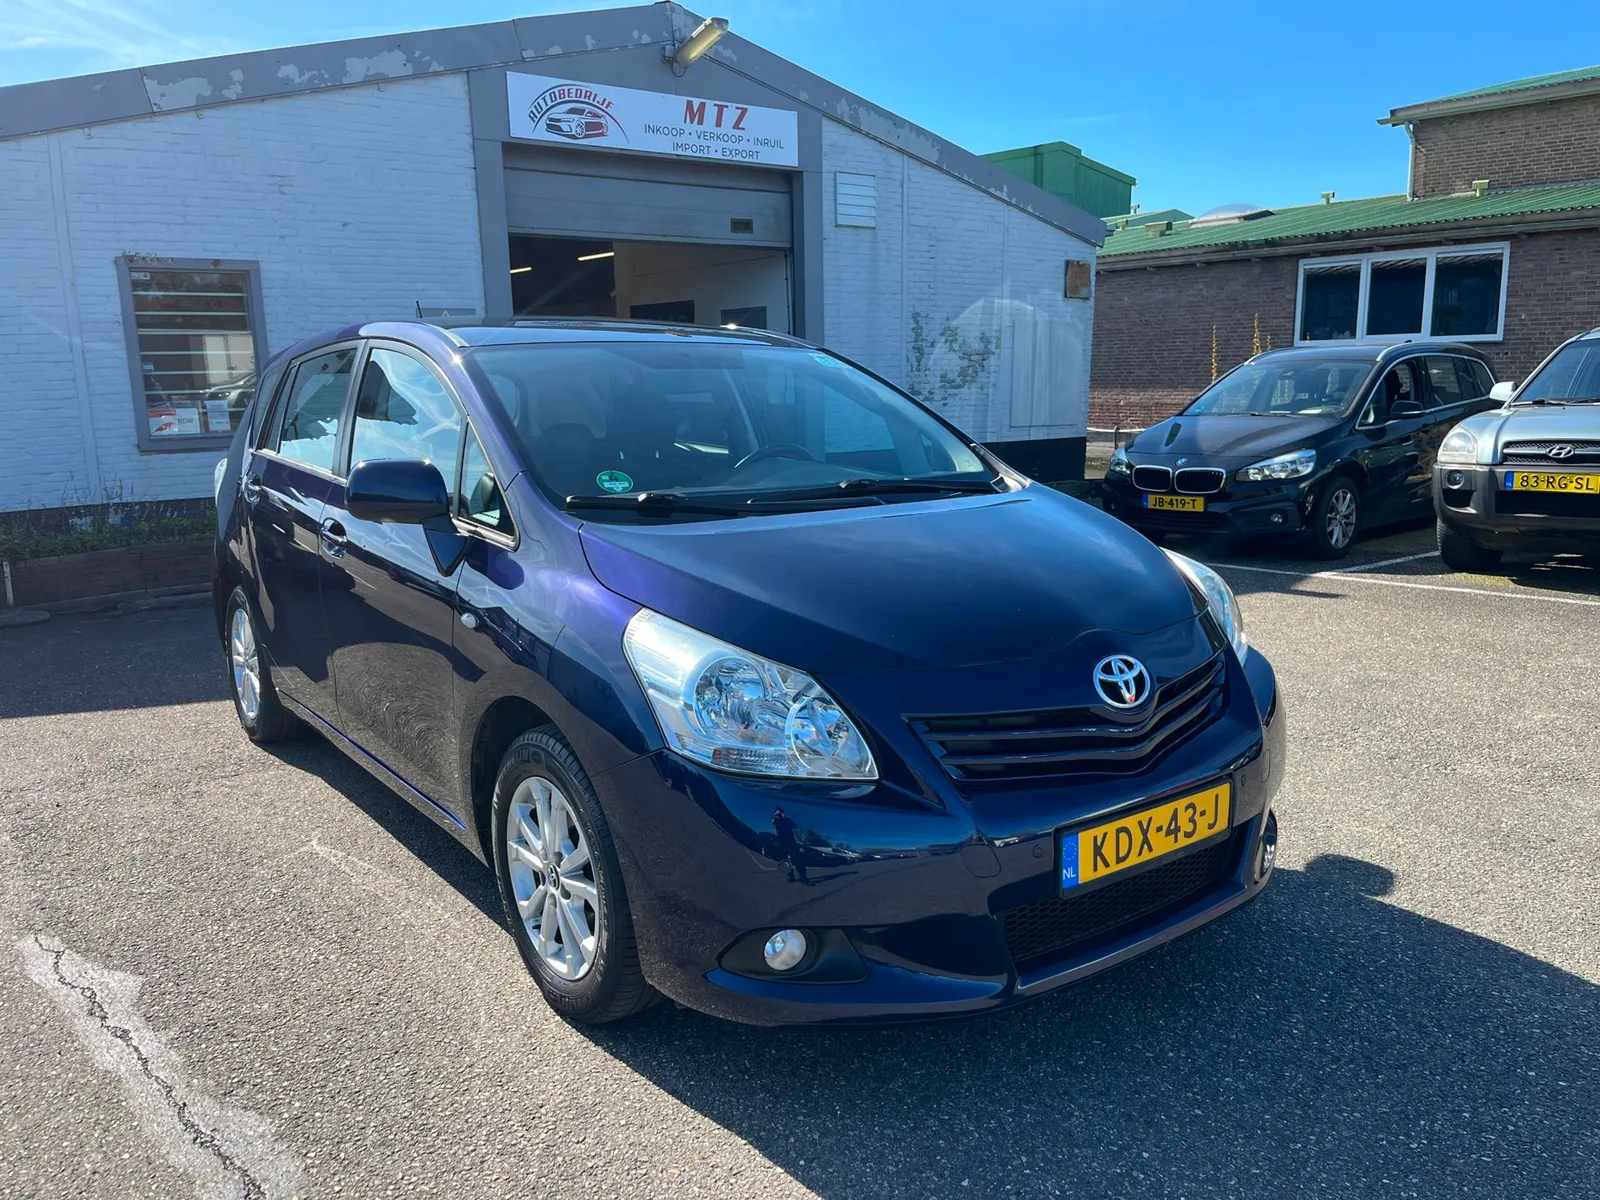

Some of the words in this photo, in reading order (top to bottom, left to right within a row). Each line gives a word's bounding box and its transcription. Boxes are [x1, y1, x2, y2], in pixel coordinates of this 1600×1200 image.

[528, 87, 615, 123] AUTOBEDRIJF
[683, 99, 749, 131] MTZ
[644, 124, 685, 138] INKOOP
[695, 130, 744, 143] VERKOOP
[753, 137, 784, 149] INRUIL
[672, 142, 712, 155] IMPORT
[721, 147, 760, 159] EXPORT
[1520, 475, 1594, 491] 83-RG-SL
[1152, 497, 1198, 509] JB-419-T
[1092, 793, 1220, 873] KDX-43-J
[1062, 867, 1077, 880] NL
